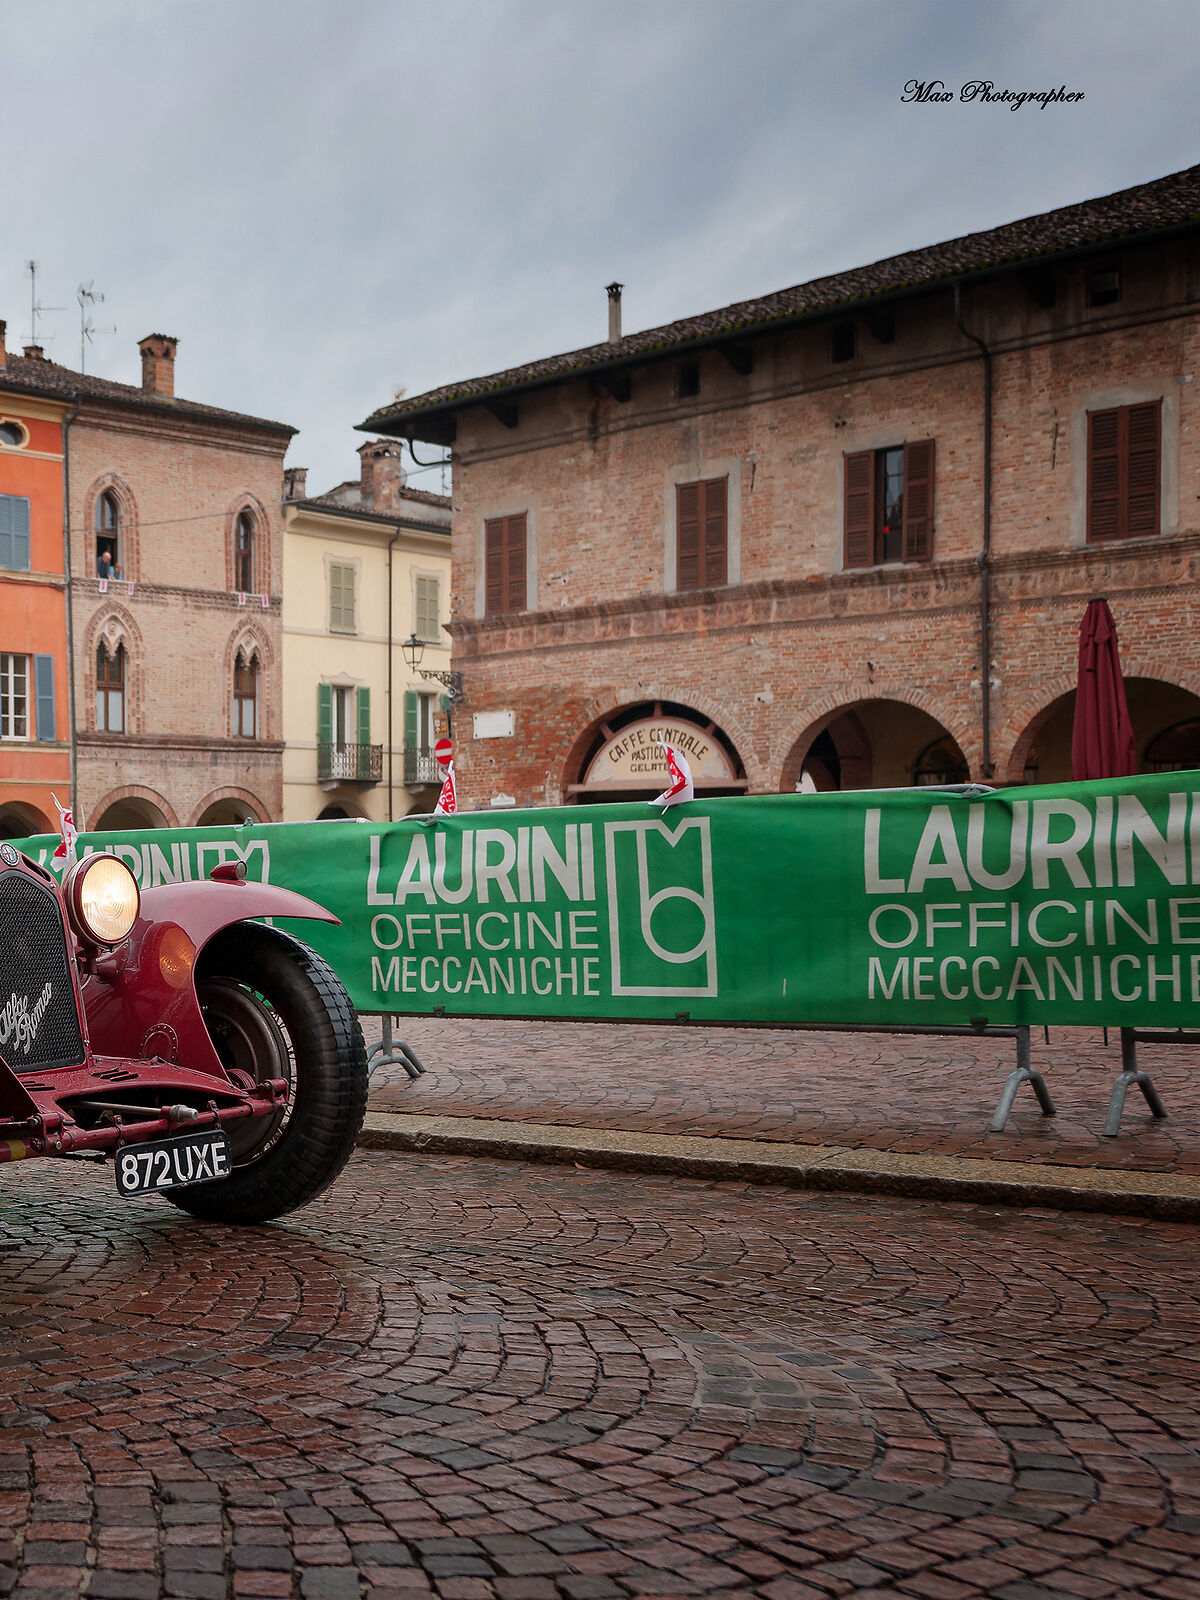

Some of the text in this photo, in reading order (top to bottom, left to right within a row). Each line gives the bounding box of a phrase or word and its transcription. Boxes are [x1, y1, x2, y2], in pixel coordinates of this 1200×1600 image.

[649, 728, 709, 760] CENTRALE
[367, 823, 596, 906] LAURINI
[370, 911, 599, 950] OFFICINE
[868, 897, 1200, 949] OFFICINE
[371, 956, 600, 996] MECCANICHE
